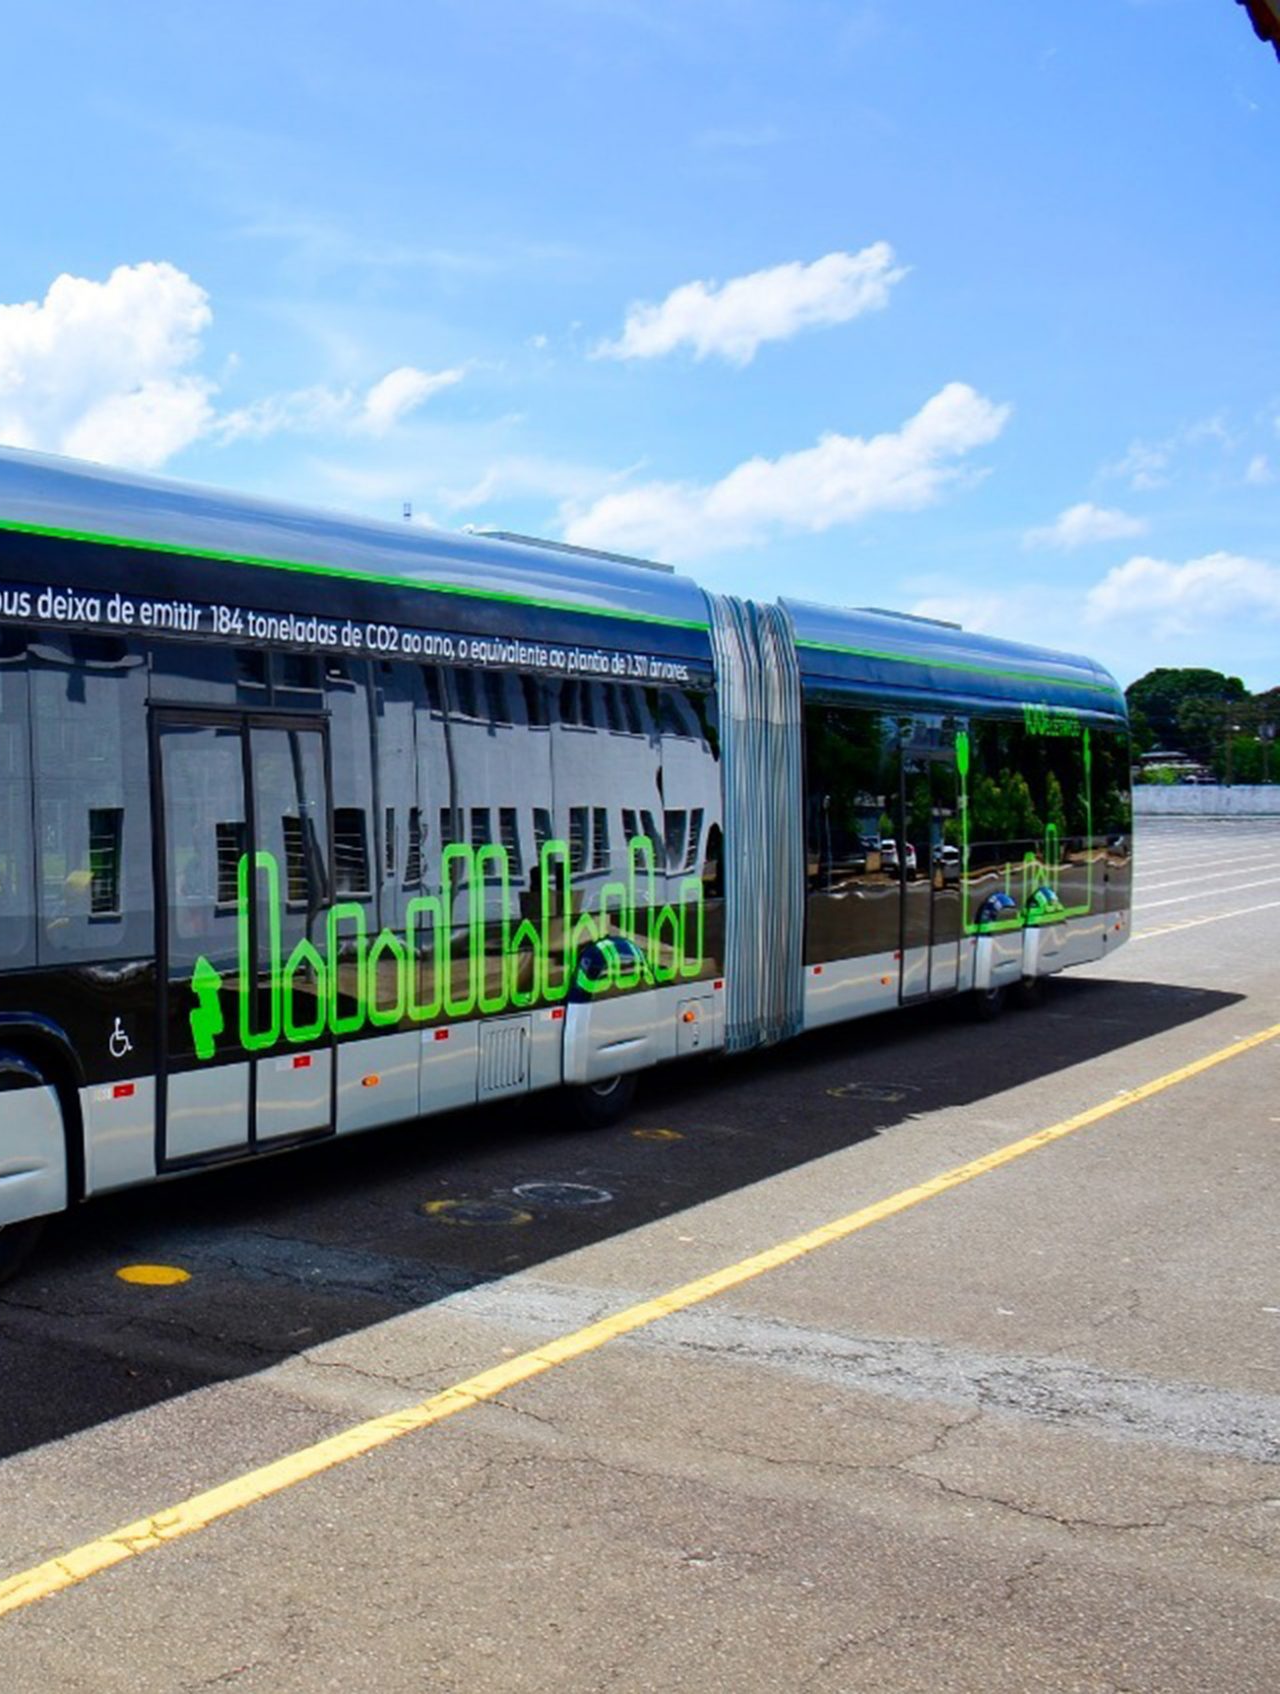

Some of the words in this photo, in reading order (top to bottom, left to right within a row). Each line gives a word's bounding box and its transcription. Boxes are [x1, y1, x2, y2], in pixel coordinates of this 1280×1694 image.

[38, 588, 100, 622] deixa
[106, 593, 136, 624] de
[140, 599, 201, 631] emitir
[211, 605, 243, 634] 184
[248, 613, 337, 645] toneladas
[341, 623, 362, 648] de
[365, 624, 399, 651] CO2
[402, 634, 421, 653] ao
[424, 635, 456, 660] ano,
[459, 641, 469, 659] o
[470, 637, 548, 667] equivalente
[549, 649, 566, 667] ao
[567, 647, 609, 673] plantio
[611, 652, 625, 674] de
